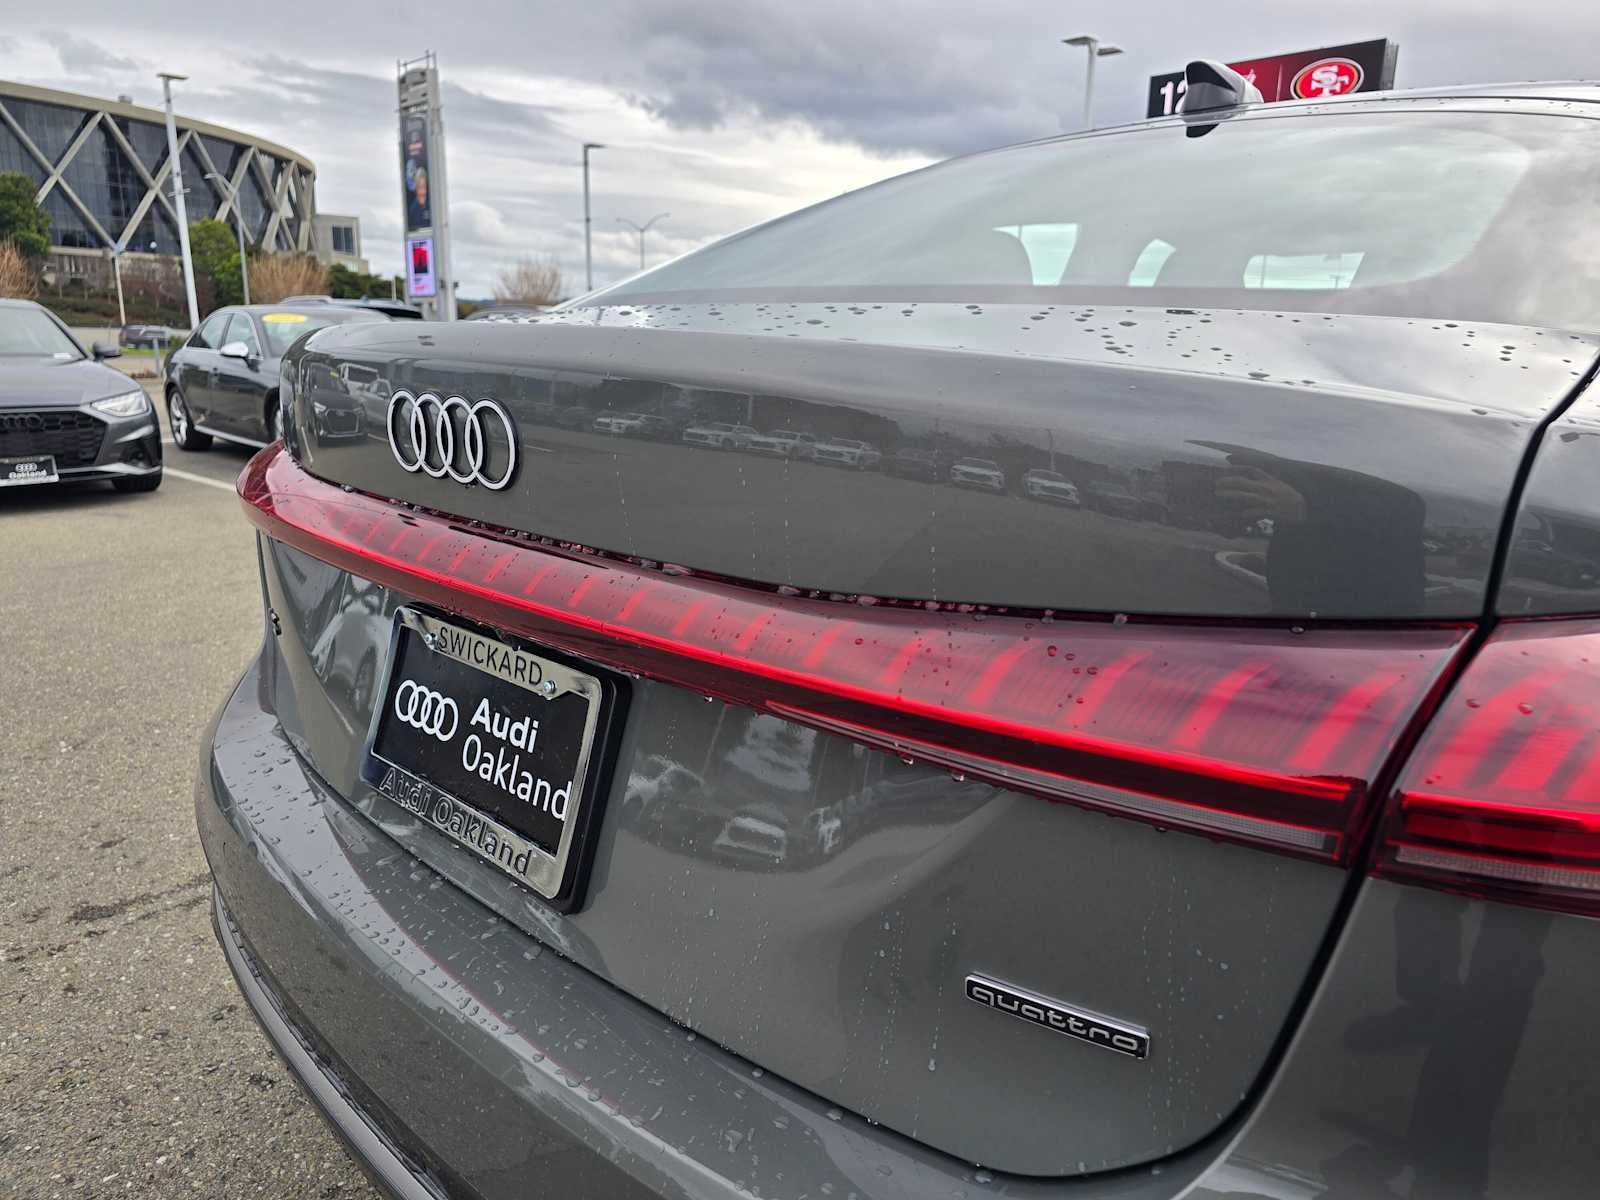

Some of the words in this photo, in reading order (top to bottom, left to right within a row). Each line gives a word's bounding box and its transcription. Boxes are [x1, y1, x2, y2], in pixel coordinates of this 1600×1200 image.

[438, 627, 543, 686] SWICKARD
[470, 698, 540, 754] Audi
[462, 735, 573, 821] Oakland
[379, 768, 431, 817] Audi
[431, 796, 533, 877] Oakland
[972, 986, 1138, 1050] quattro
